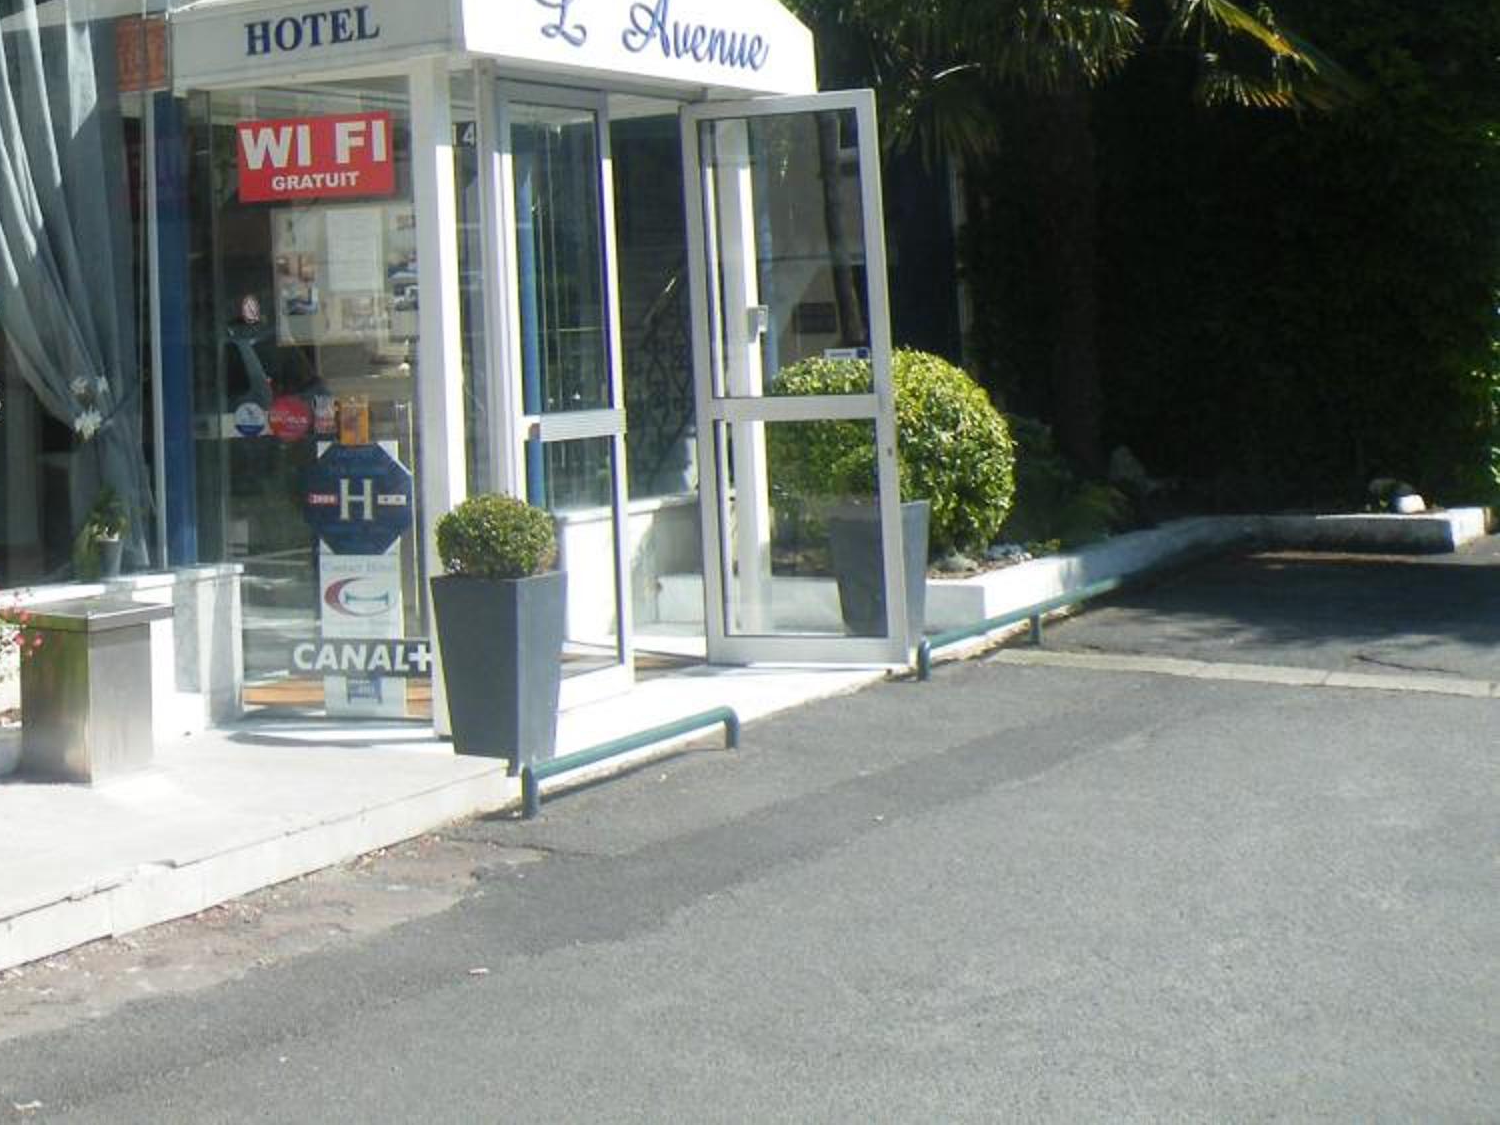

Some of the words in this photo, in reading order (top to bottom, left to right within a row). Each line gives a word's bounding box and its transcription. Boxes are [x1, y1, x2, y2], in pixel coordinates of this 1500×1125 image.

[244, 5, 381, 56] HOTEL
[240, 125, 311, 170] WI
[335, 119, 387, 165] FI
[272, 171, 360, 191] GRATUIT
[339, 478, 373, 521] H
[293, 642, 432, 672] CANAL+
